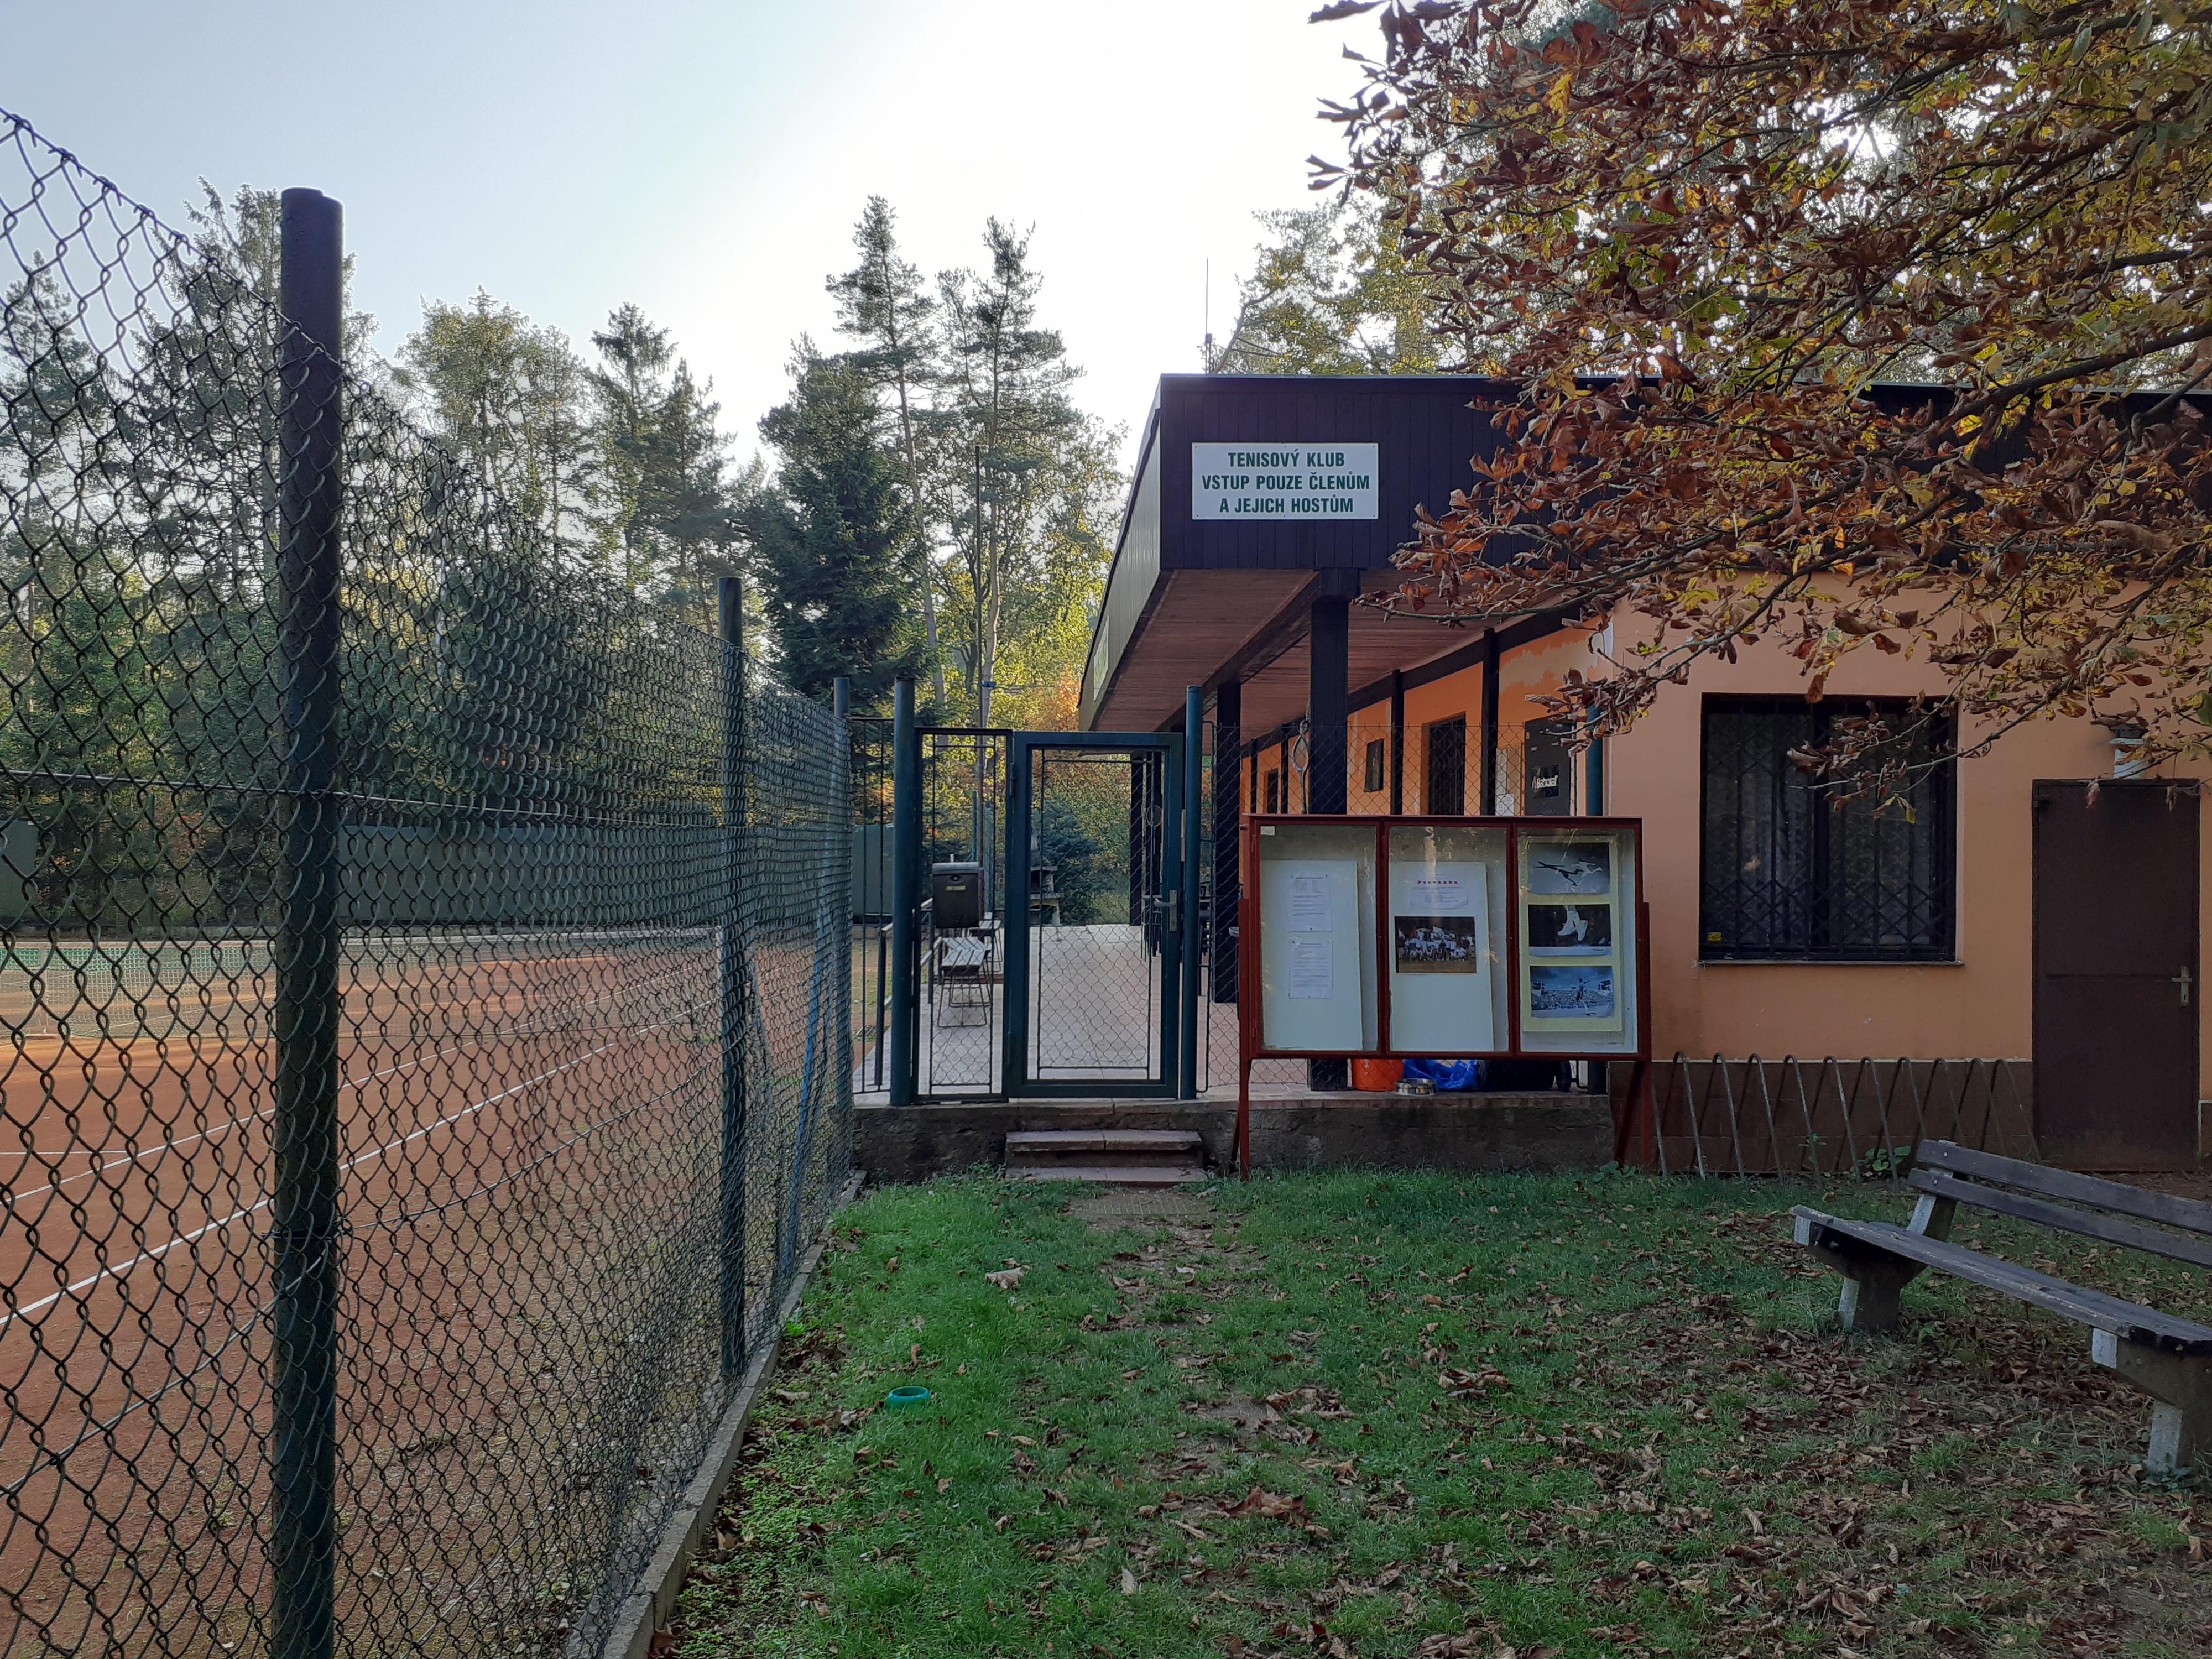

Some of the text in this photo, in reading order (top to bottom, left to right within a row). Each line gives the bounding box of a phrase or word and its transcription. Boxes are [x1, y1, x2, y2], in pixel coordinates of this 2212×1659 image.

[1228, 448, 1345, 467] TENISOVÝ KLUB
[1202, 471, 1370, 490] VSTUP POUZE ČLENŮM
[1219, 494, 1353, 513] A JEJICH HOSTŮM
